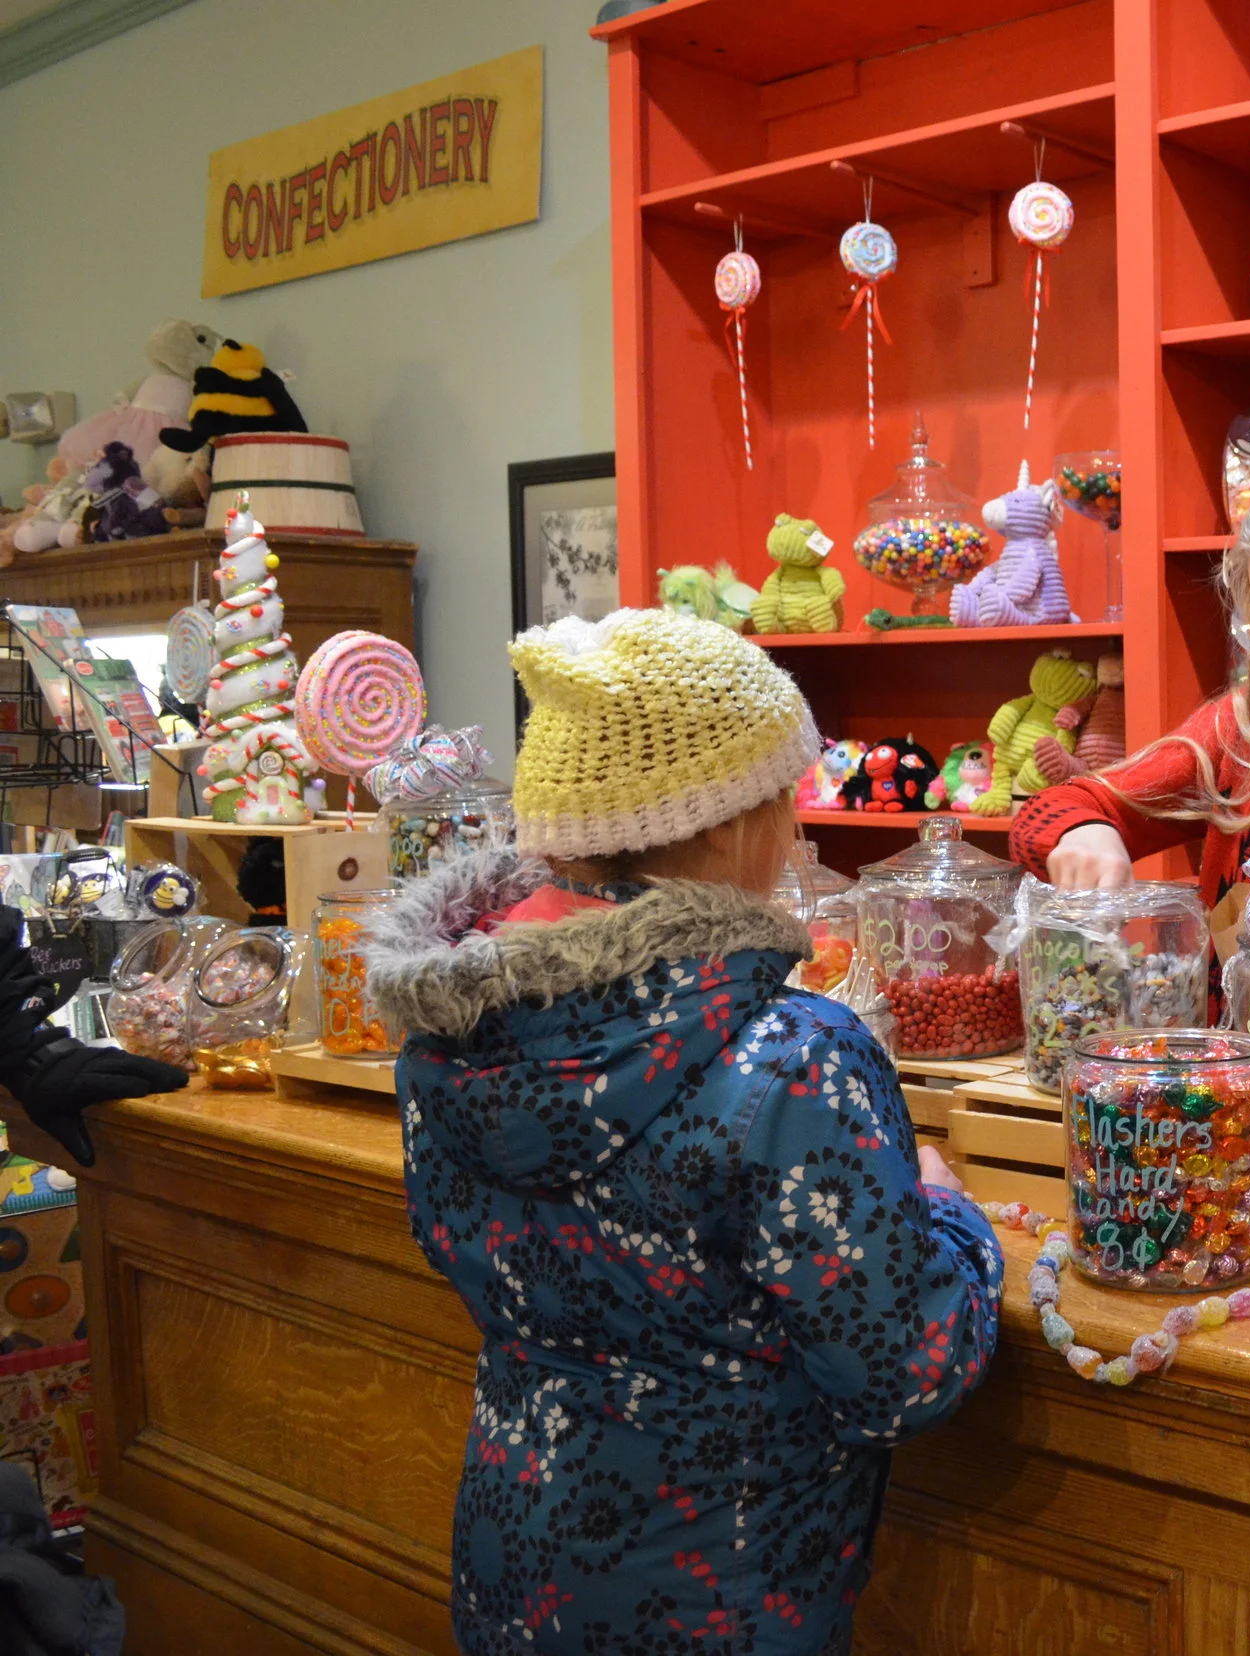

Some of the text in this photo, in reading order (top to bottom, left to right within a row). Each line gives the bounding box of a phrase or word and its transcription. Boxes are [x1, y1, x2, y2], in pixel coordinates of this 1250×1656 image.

[221, 97, 498, 261] CONFECTIONERY
[1072, 1093, 1213, 1151] Flashers
[1096, 1153, 1178, 1196] Hard
